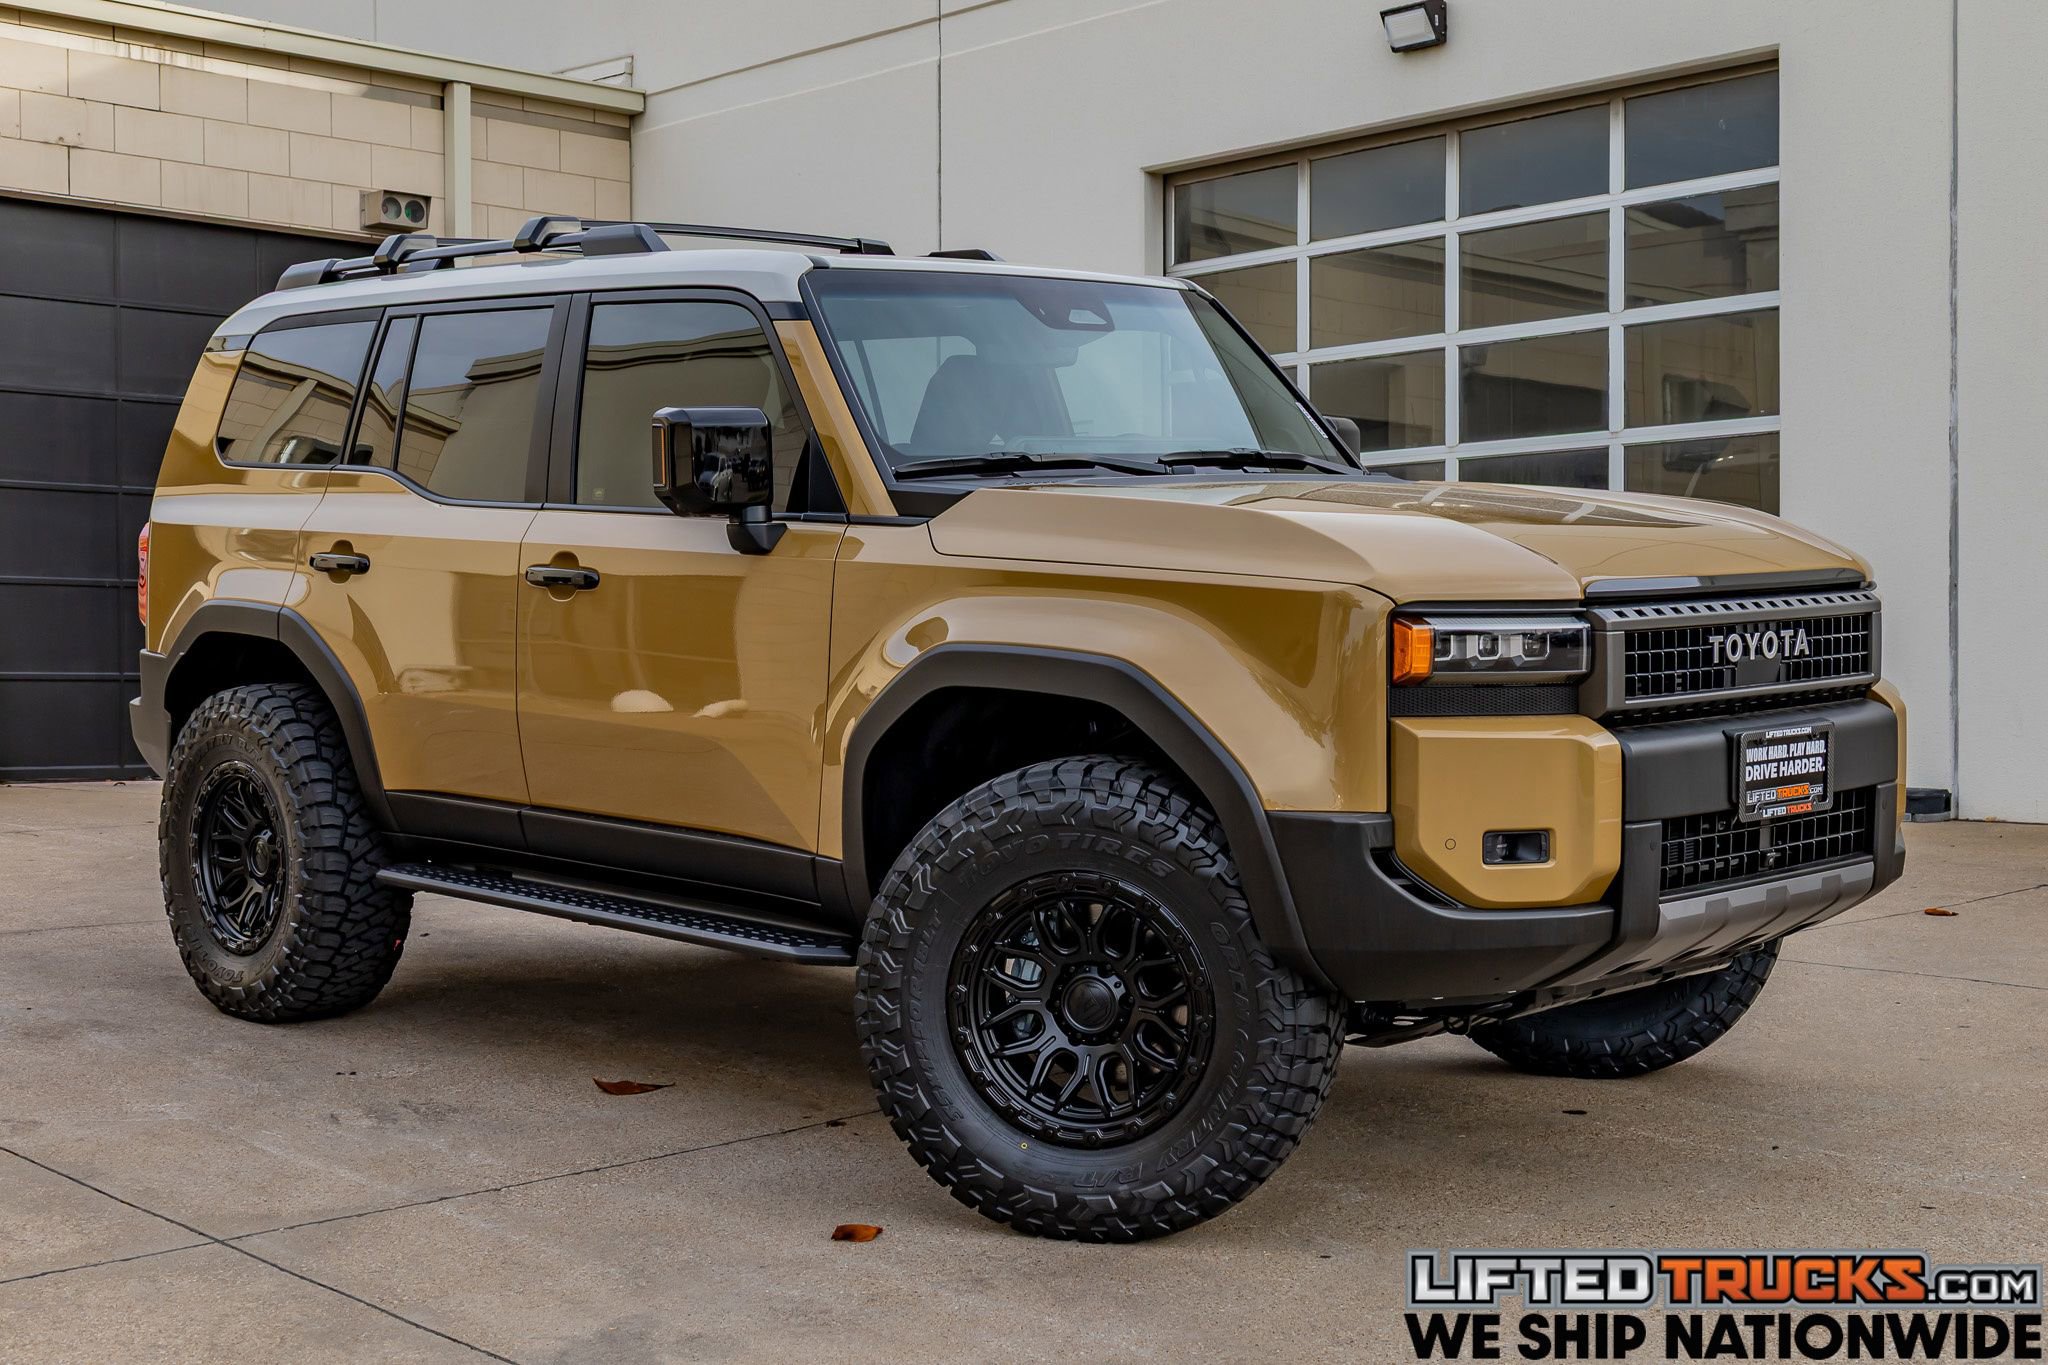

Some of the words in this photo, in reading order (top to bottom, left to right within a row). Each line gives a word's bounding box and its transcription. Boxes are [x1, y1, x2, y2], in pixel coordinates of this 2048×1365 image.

[1708, 628, 1810, 664] TOYOTA
[1746, 746, 1768, 763] WORK
[1768, 744, 1789, 760] HARD.
[1789, 742, 1806, 758] PLAY
[1805, 740, 1827, 755] HARD.
[1745, 762, 1778, 782] DRIVE
[1779, 756, 1826, 777] HARDER.
[959, 833, 1050, 889] TOYO
[1057, 832, 1177, 878] TIRES
